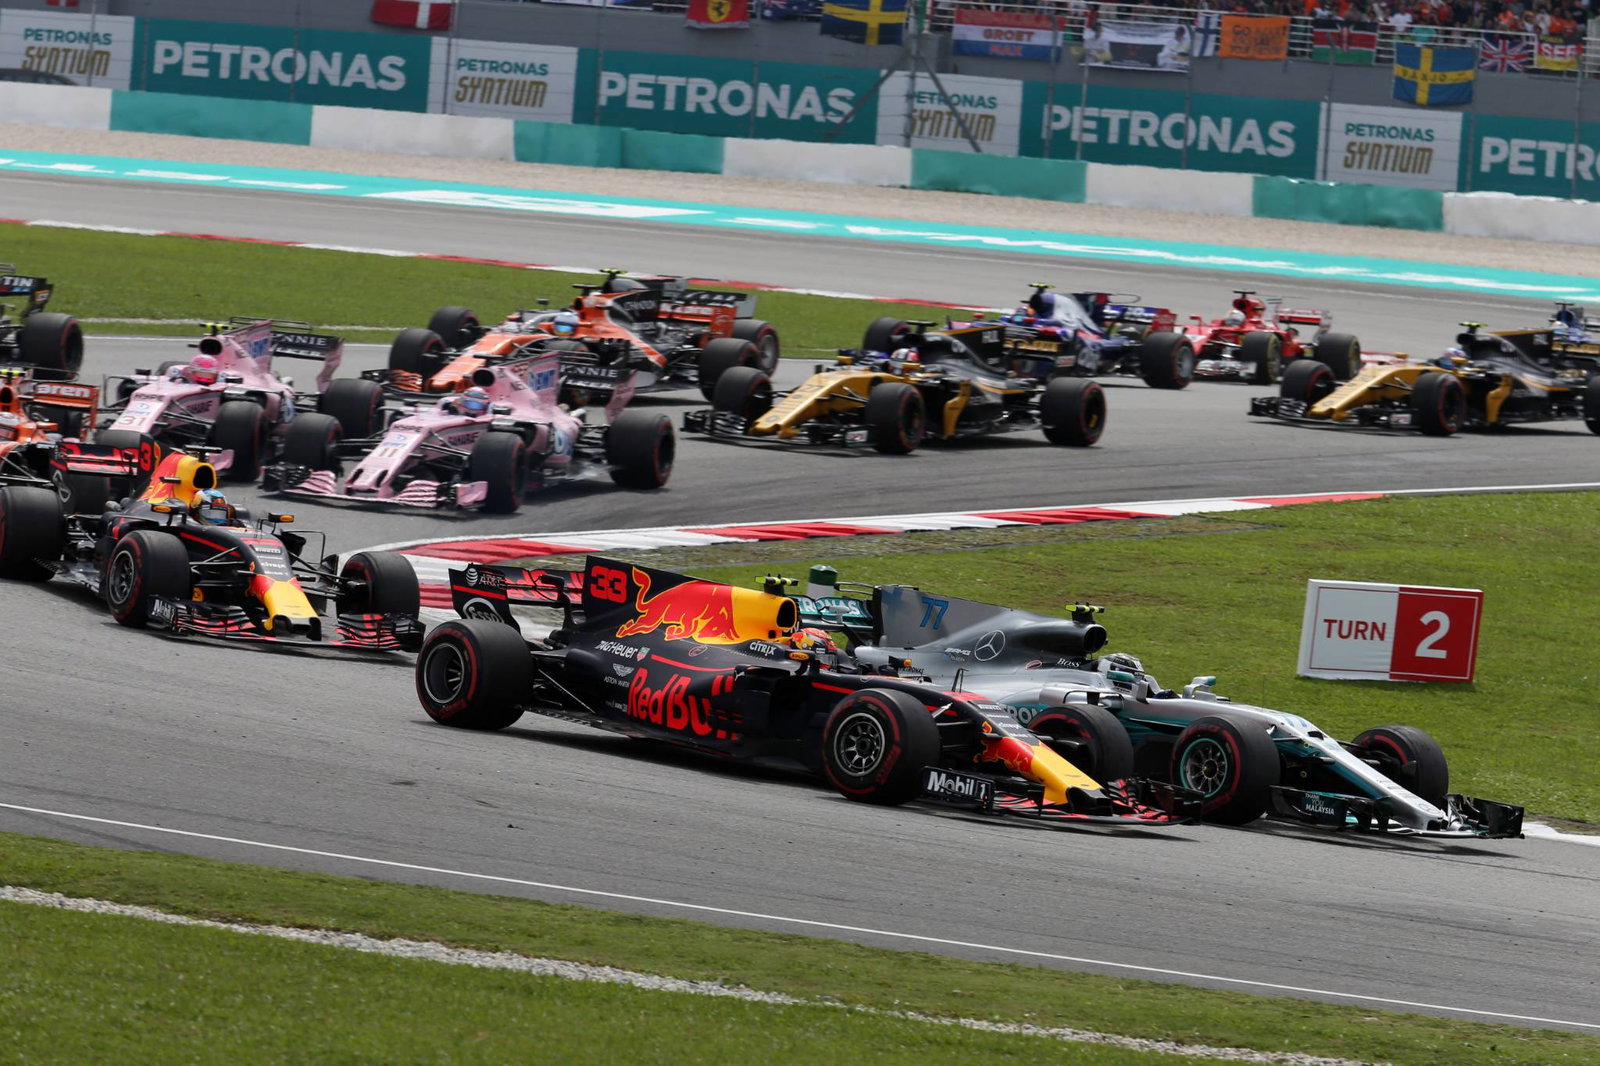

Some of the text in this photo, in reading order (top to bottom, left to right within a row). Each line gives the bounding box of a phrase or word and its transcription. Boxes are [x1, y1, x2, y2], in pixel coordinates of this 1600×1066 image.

[24, 28, 112, 45] PETRONAS
[22, 46, 111, 76] SYNTIUM
[153, 39, 407, 91] PETRONAS
[456, 57, 549, 76] PETRONAS
[455, 76, 548, 108] SYNTIUM
[599, 71, 856, 123] PETRONAS
[1042, 104, 1296, 157] PETRONAS
[1345, 122, 1434, 142] PETRONAS
[1343, 141, 1433, 174] SYNTIUM
[273, 331, 326, 346] NNIE
[561, 365, 618, 378] NNIE
[36, 385, 91, 399] aren
[119, 415, 147, 426] 31
[590, 564, 627, 603] 33
[797, 597, 860, 614] TRONAS
[920, 596, 949, 630] 77
[1323, 610, 1450, 659] TURN 2
[927, 771, 986, 798] Mobil 1
[1305, 803, 1335, 816] MALAYSIA
